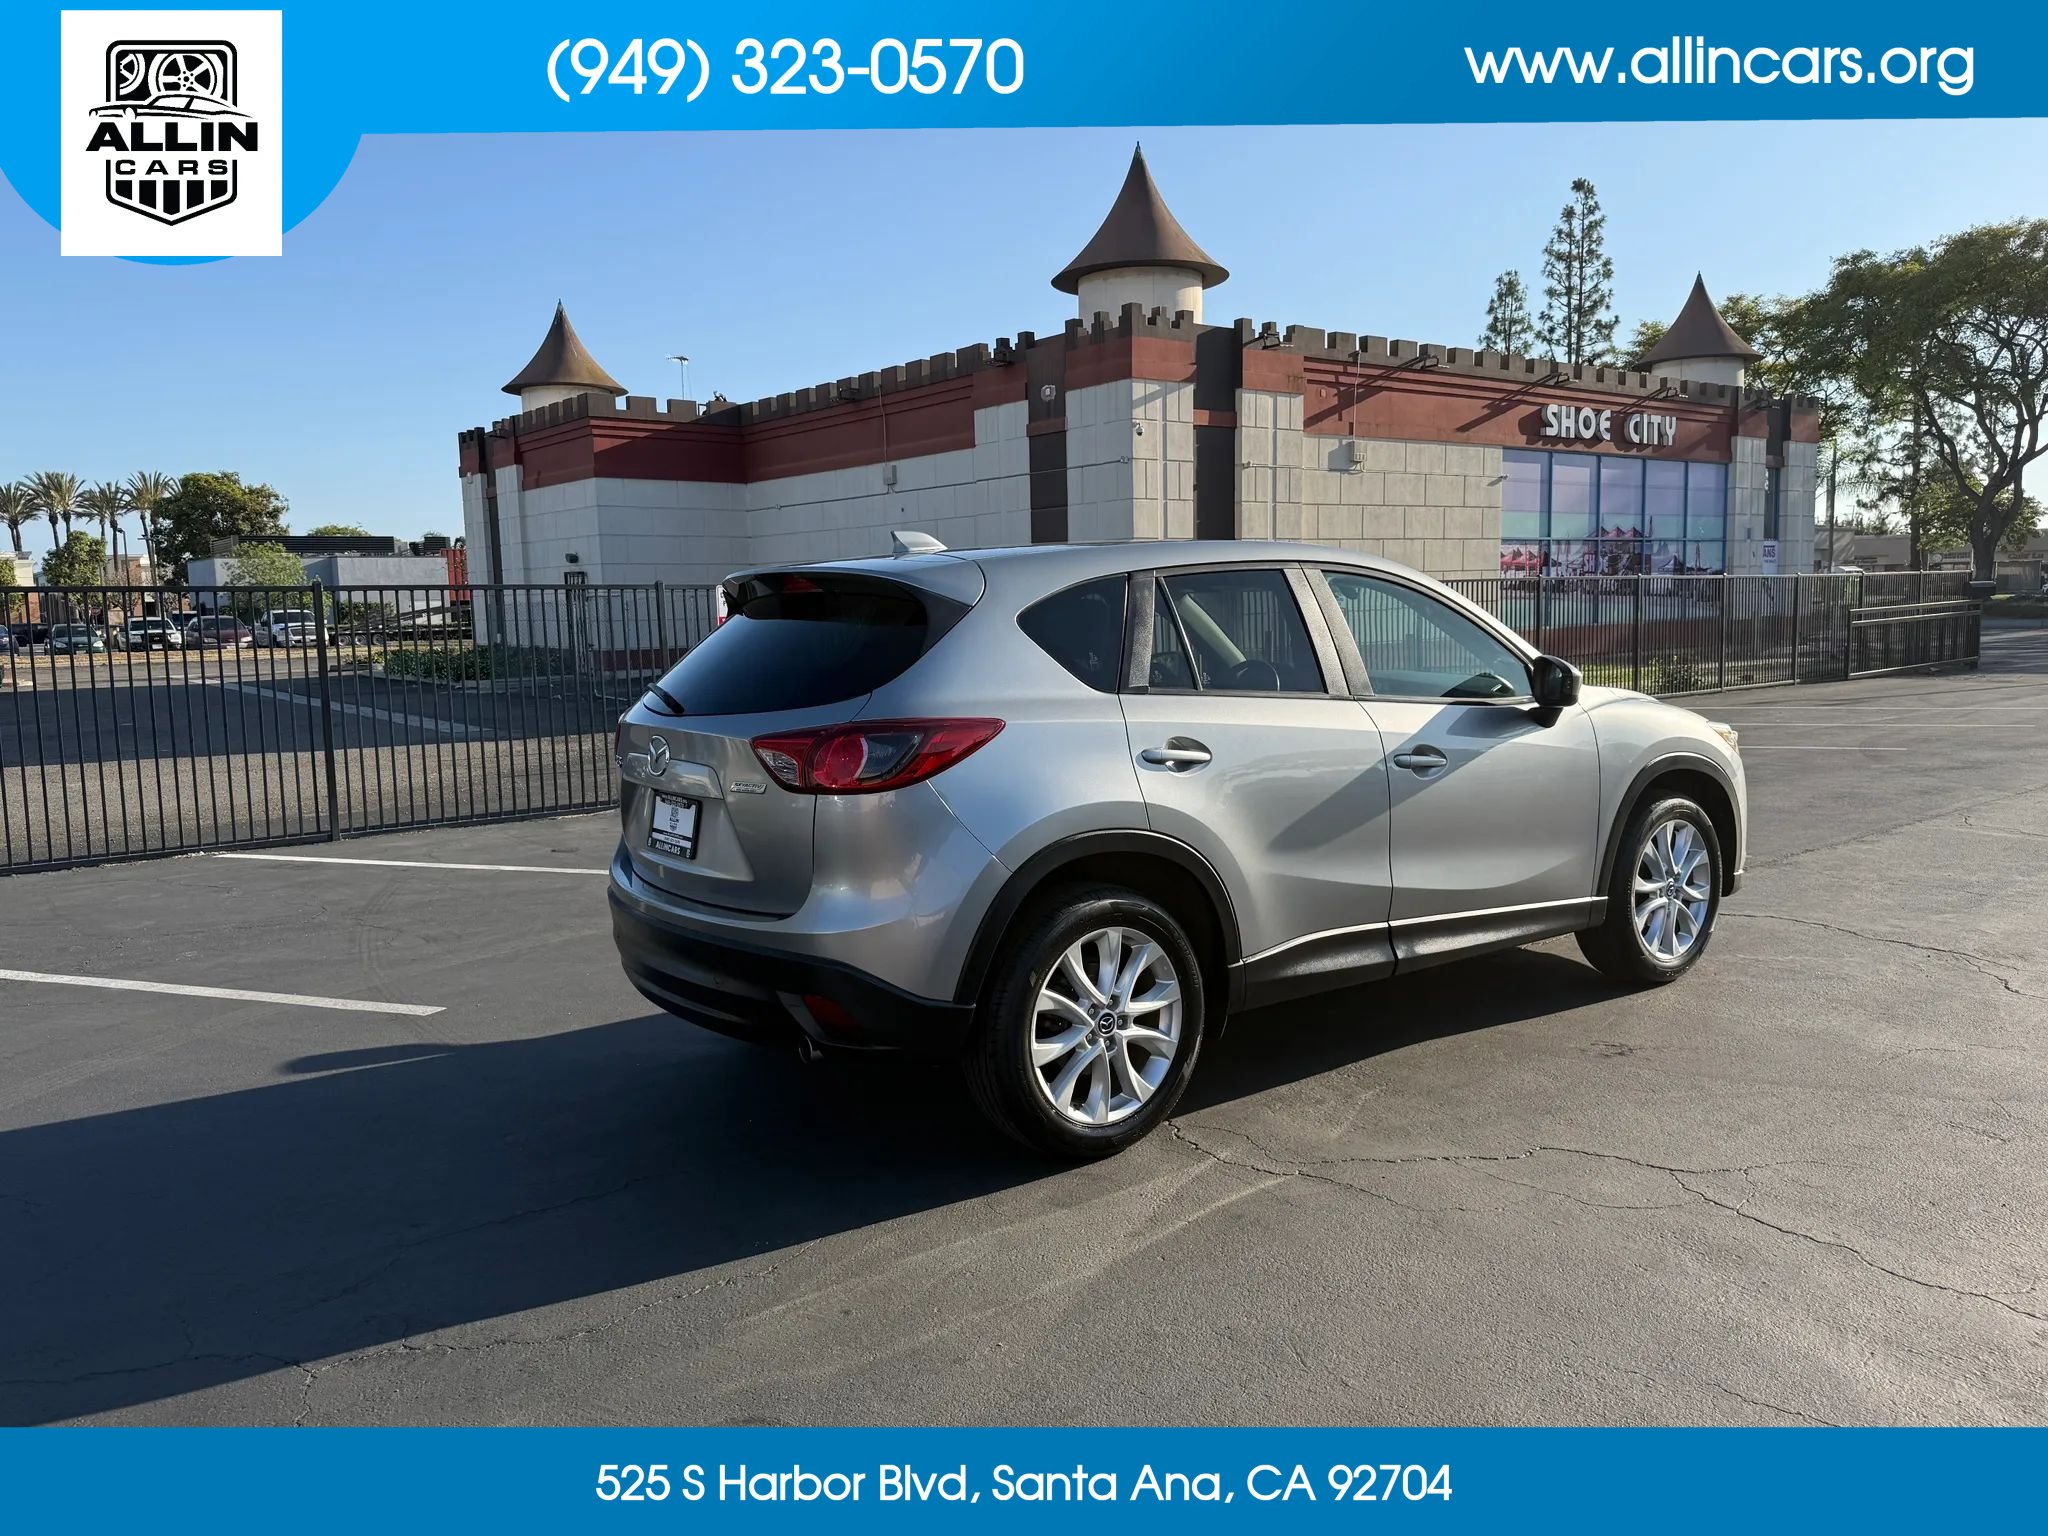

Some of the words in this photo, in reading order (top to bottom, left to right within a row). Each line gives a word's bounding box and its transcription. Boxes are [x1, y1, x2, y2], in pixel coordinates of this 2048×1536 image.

[1544, 404, 1611, 440] SHOE
[1628, 413, 1677, 446] CITY
[1763, 544, 1776, 558] ANS
